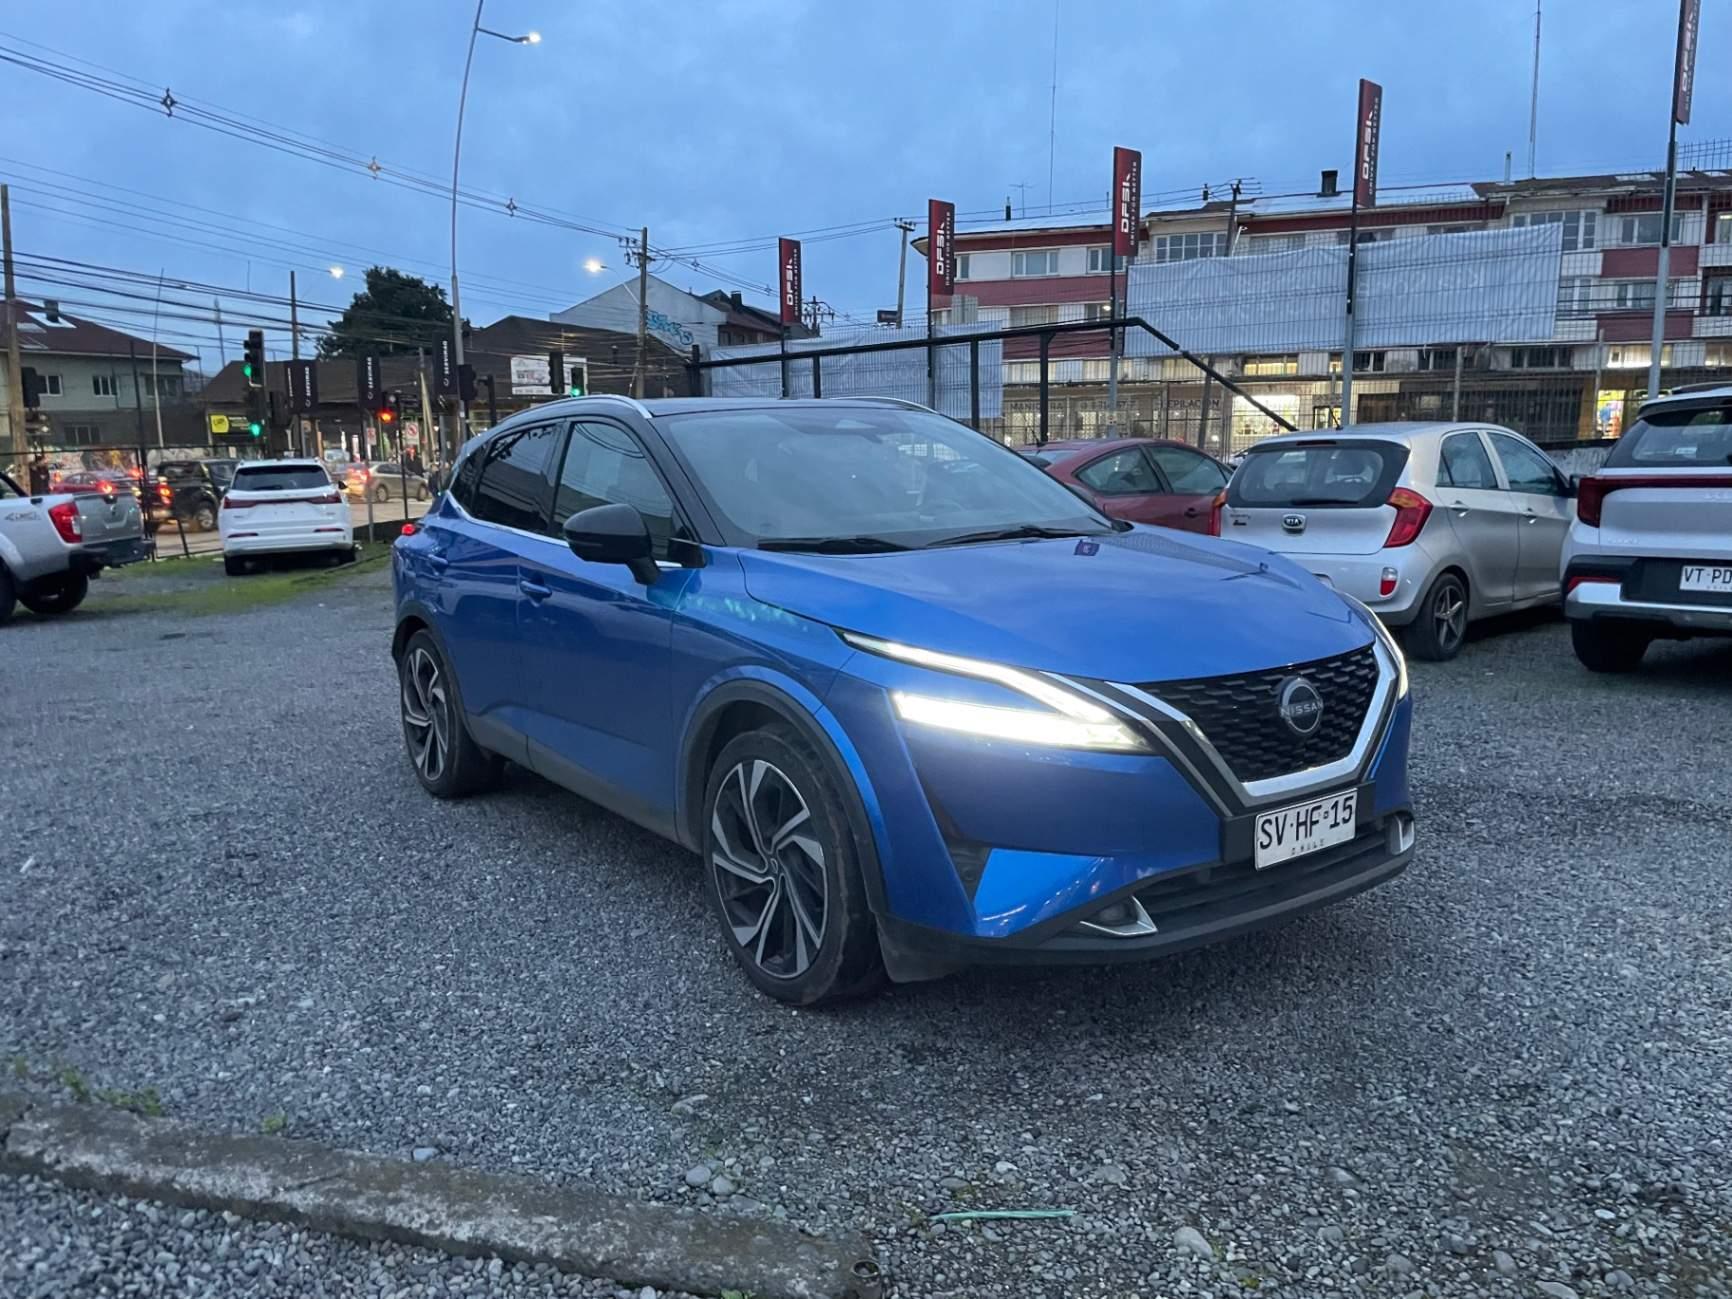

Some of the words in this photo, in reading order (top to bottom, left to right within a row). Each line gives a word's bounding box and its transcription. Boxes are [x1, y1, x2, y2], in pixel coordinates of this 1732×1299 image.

[1121, 173, 1131, 233] DFSK
[936, 222, 945, 275] DFSK
[1280, 700, 1324, 718] NISSAN
